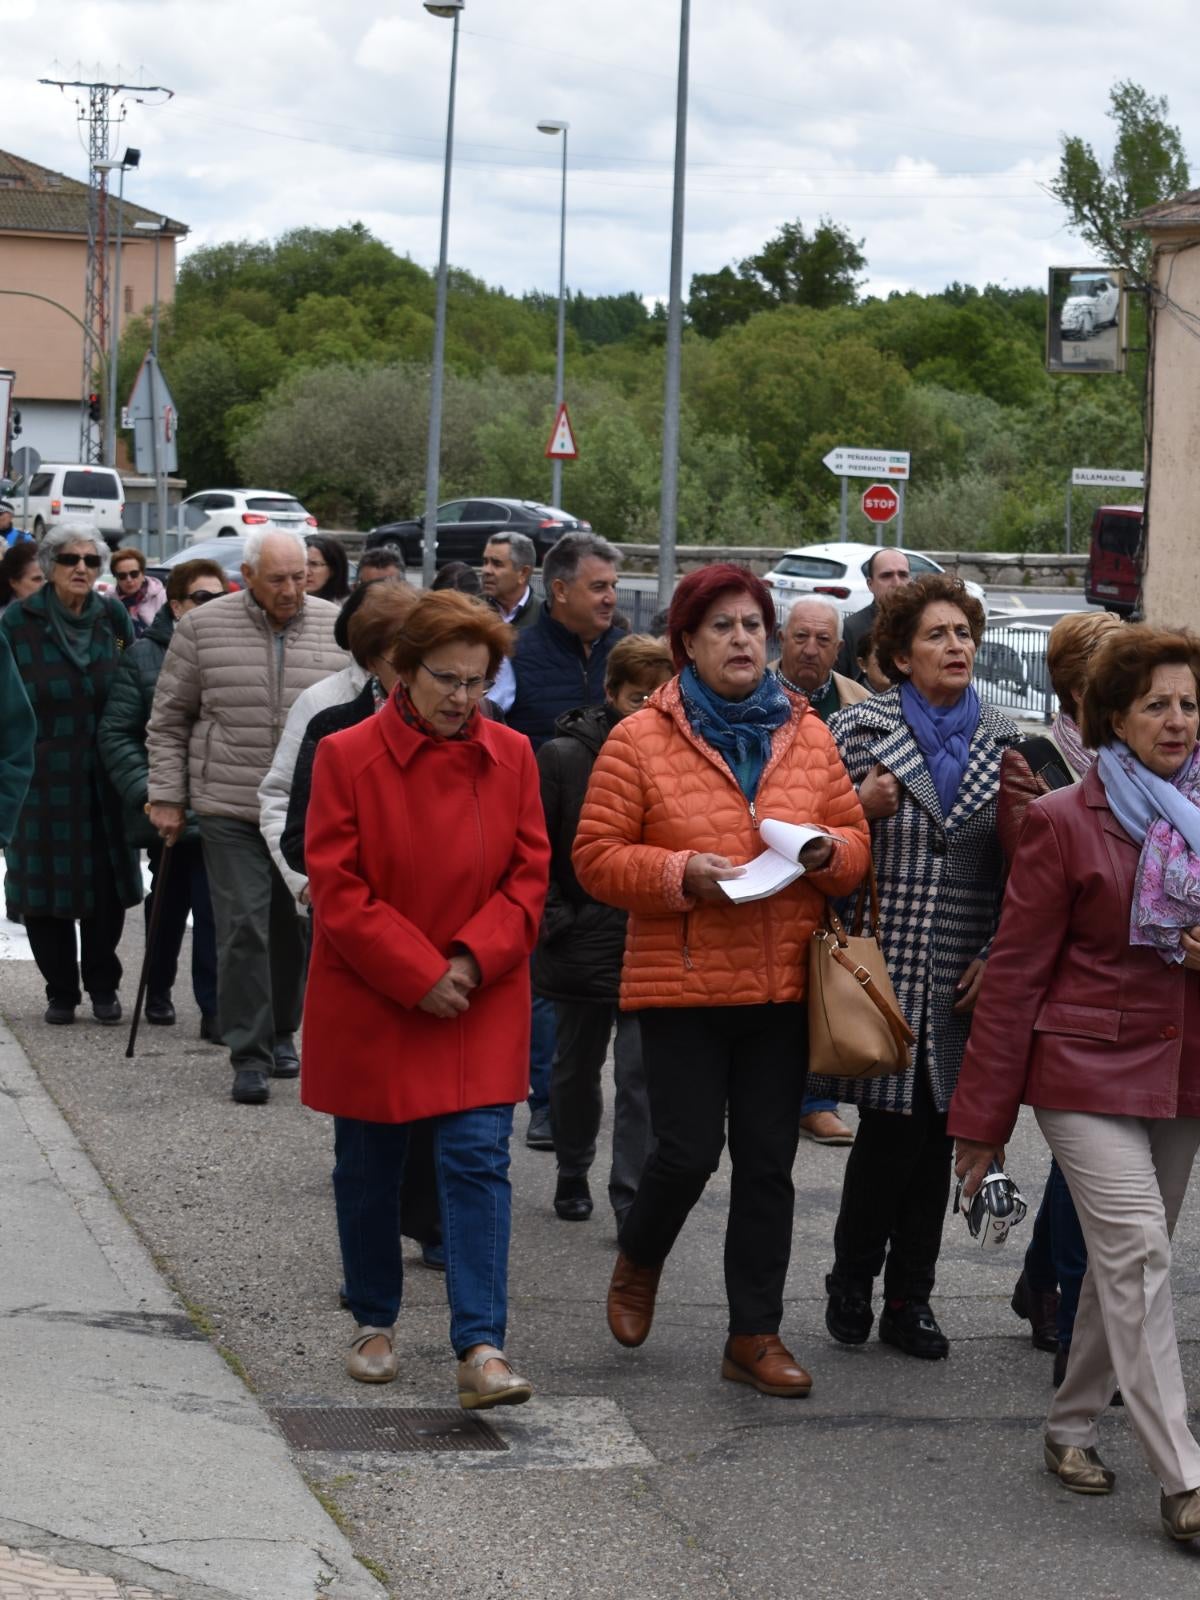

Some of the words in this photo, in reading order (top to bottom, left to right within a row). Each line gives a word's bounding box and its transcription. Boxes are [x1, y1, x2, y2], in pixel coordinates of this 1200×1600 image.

[847, 453, 886, 462] PEÑARANDA
[1075, 473, 1126, 481] SALAMANCA
[865, 499, 895, 509] STOP
